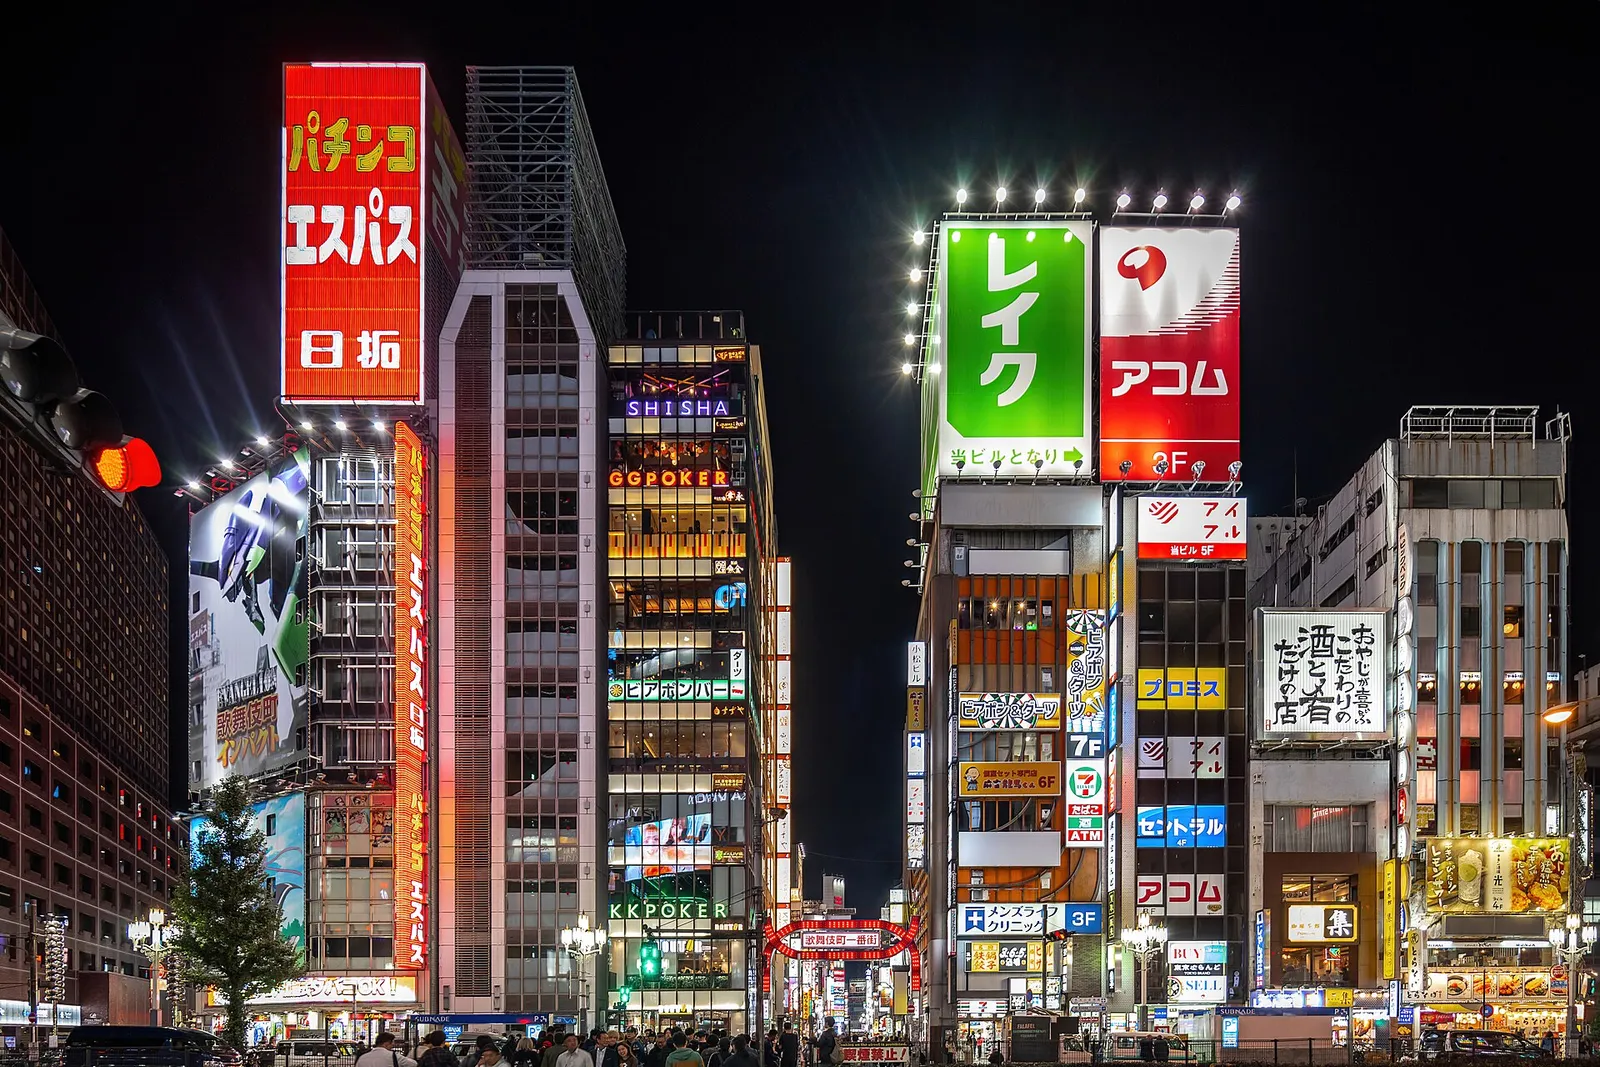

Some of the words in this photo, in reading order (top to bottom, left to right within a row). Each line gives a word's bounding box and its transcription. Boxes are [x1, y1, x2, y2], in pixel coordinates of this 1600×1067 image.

[288, 109, 416, 173] パチンコ
[285, 187, 417, 265] エスパス
[980, 237, 1040, 407] レイク
[300, 330, 400, 369] 日拓
[1111, 360, 1229, 397] アコム
[628, 400, 728, 416] SHISHA
[950, 447, 1058, 466] 当ビルとなり
[609, 470, 727, 487] GGPOKER
[1202, 502, 1239, 517] アイ
[1170, 545, 1197, 556] 当ビル
[1201, 545, 1214, 556] 5F
[410, 552, 424, 699] エスパス
[733, 650, 742, 677] ダーツ
[911, 644, 922, 683] 小松ビル
[1086, 628, 1104, 691] ビアポン
[627, 682, 727, 698] ビアポンバー
[1143, 678, 1220, 697] プロミス
[1272, 639, 1300, 725] だけの店
[1335, 636, 1355, 724] こだわりの
[216, 694, 279, 739] 歌舞伎町
[216, 724, 280, 769] インパクト
[1070, 734, 1102, 757] 7F
[1038, 775, 1056, 789] 6F
[1071, 804, 1100, 815] たばこ
[410, 792, 423, 872] パチンコ
[1070, 830, 1101, 841] ATM
[1137, 816, 1224, 837] セントラル
[909, 859, 923, 868] 7F
[1493, 875, 1503, 886] 光
[1138, 880, 1222, 904] アコム
[410, 880, 424, 963] エスパス
[610, 903, 727, 919] KKPOKER
[1072, 911, 1097, 927] 3F
[1327, 909, 1353, 937] 集
[805, 934, 877, 945] 歌舞伎町一番街
[1173, 947, 1203, 960] BUY
[1185, 980, 1223, 991] SELL
